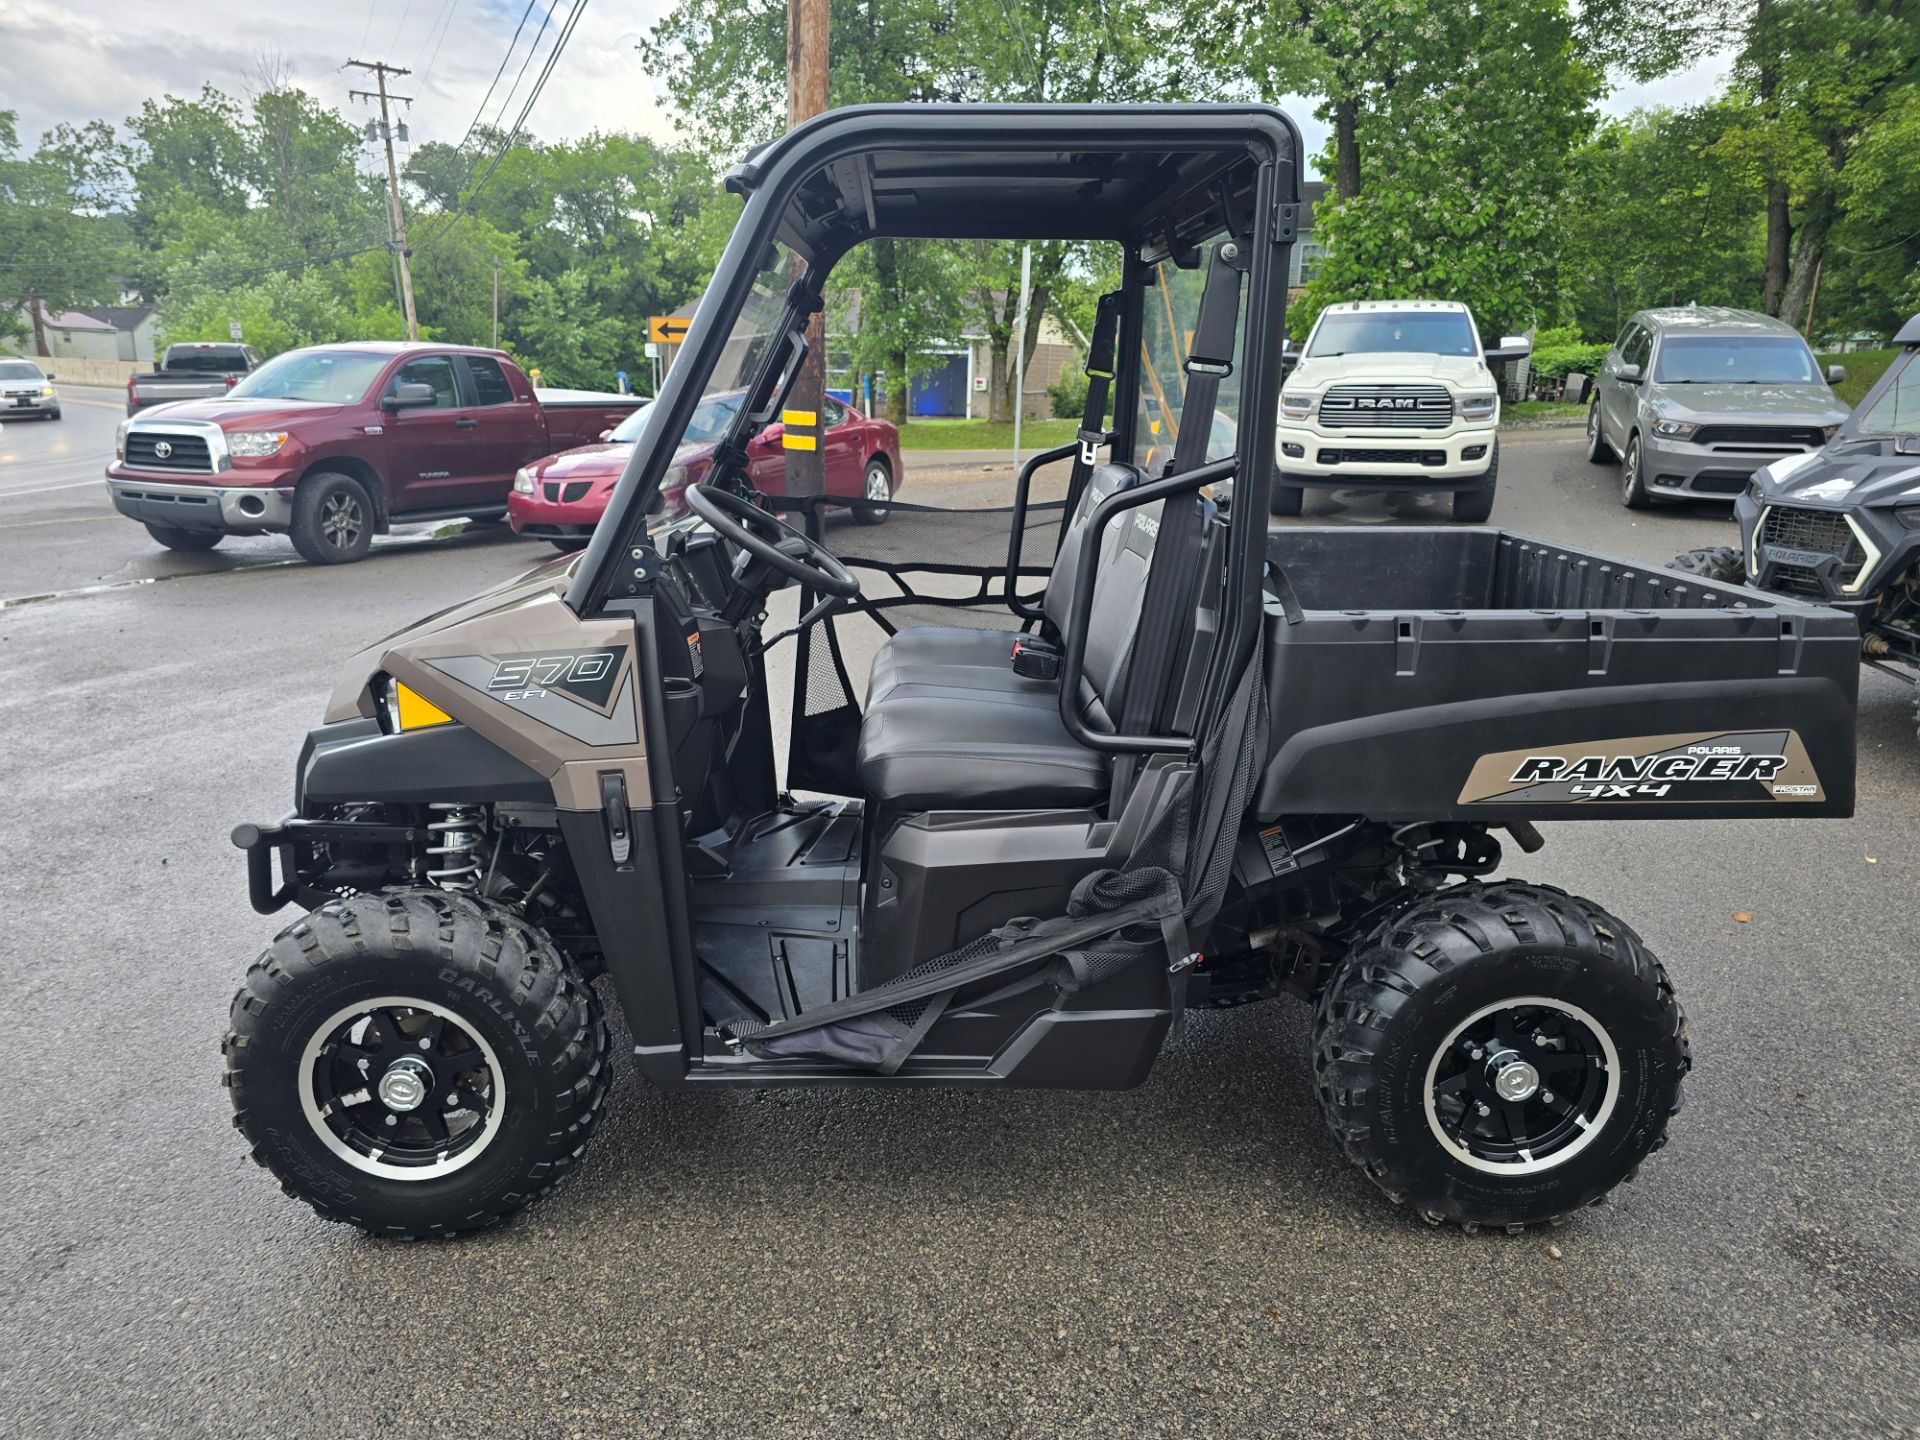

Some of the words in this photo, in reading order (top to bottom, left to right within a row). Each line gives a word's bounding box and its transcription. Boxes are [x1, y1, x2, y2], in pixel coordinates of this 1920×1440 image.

[1357, 398, 1415, 409] RAM
[1768, 548, 1820, 565] POLARIS
[487, 653, 614, 690] 570
[503, 689, 548, 701] EFI
[1687, 746, 1742, 755] POLARIS
[1509, 755, 1788, 782] RANGER
[437, 966, 543, 1069] CARLISLE
